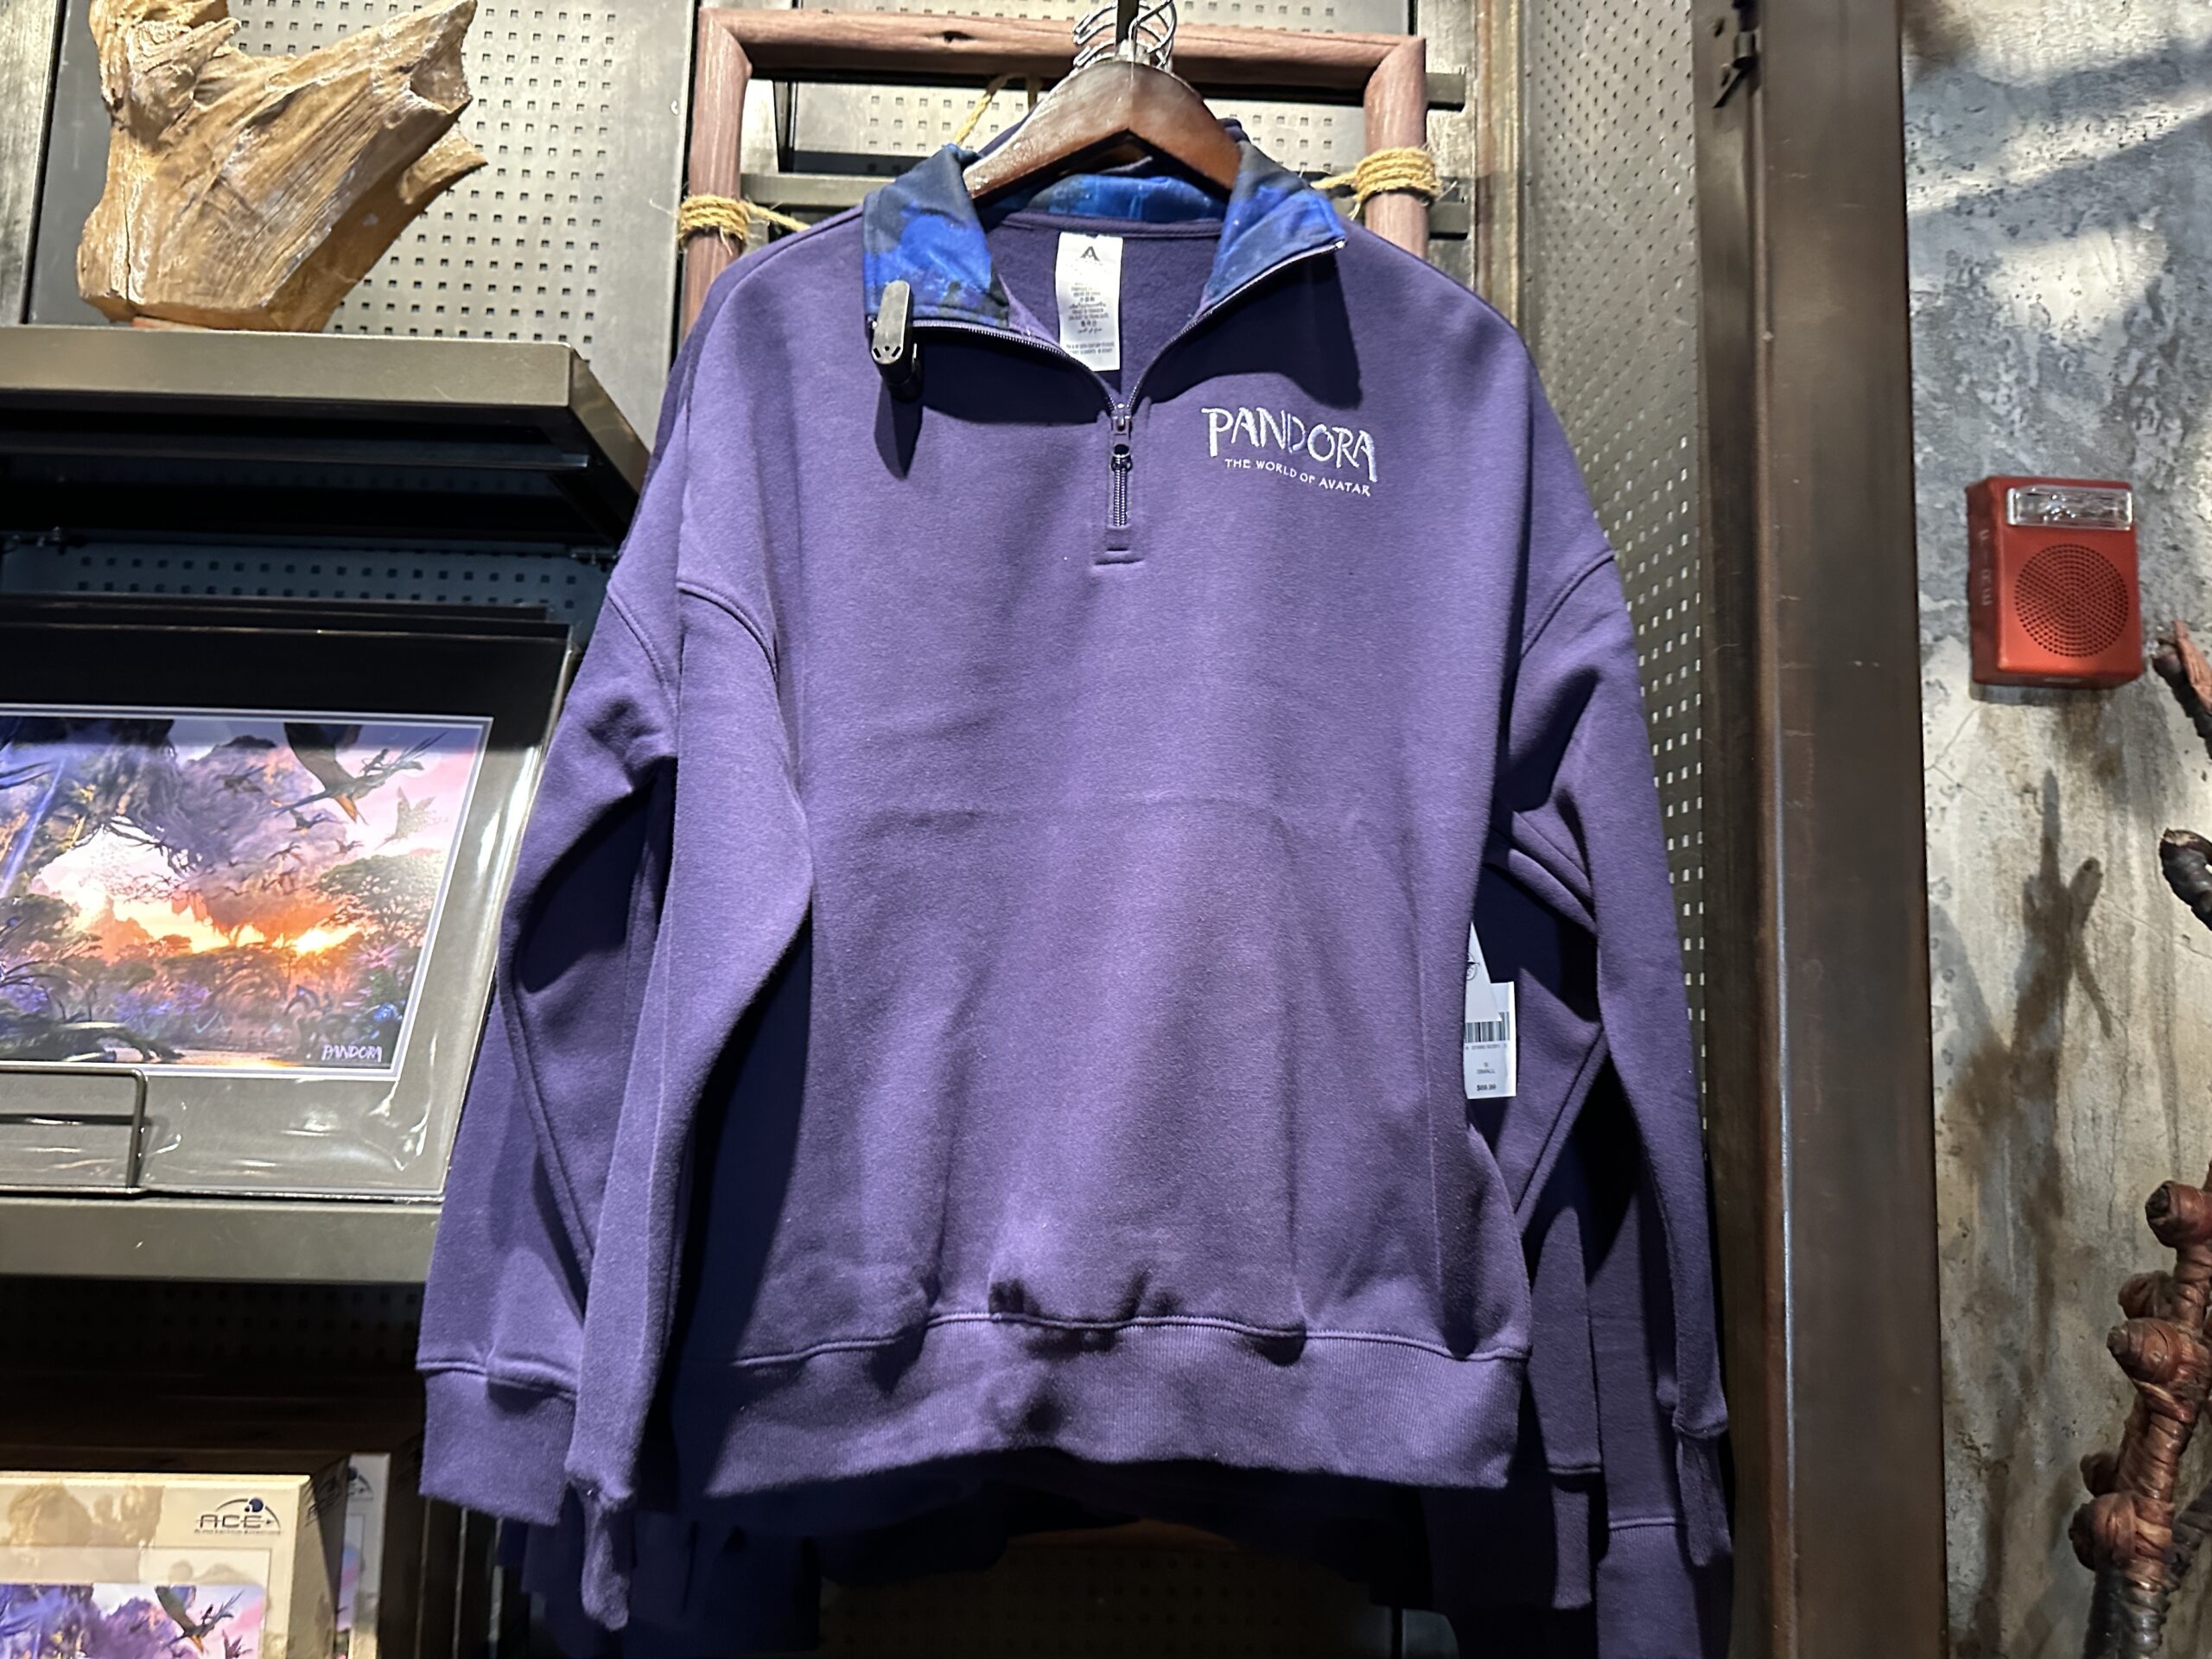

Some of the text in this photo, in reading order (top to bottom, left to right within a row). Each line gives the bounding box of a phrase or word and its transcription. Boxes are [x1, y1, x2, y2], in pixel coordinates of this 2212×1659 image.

[1200, 406, 1378, 483] PANDORA
[1224, 458, 1371, 498] THE WORLD OF AVATAR
[321, 1044, 383, 1063] PANDORA
[200, 1514, 263, 1529] ACE
